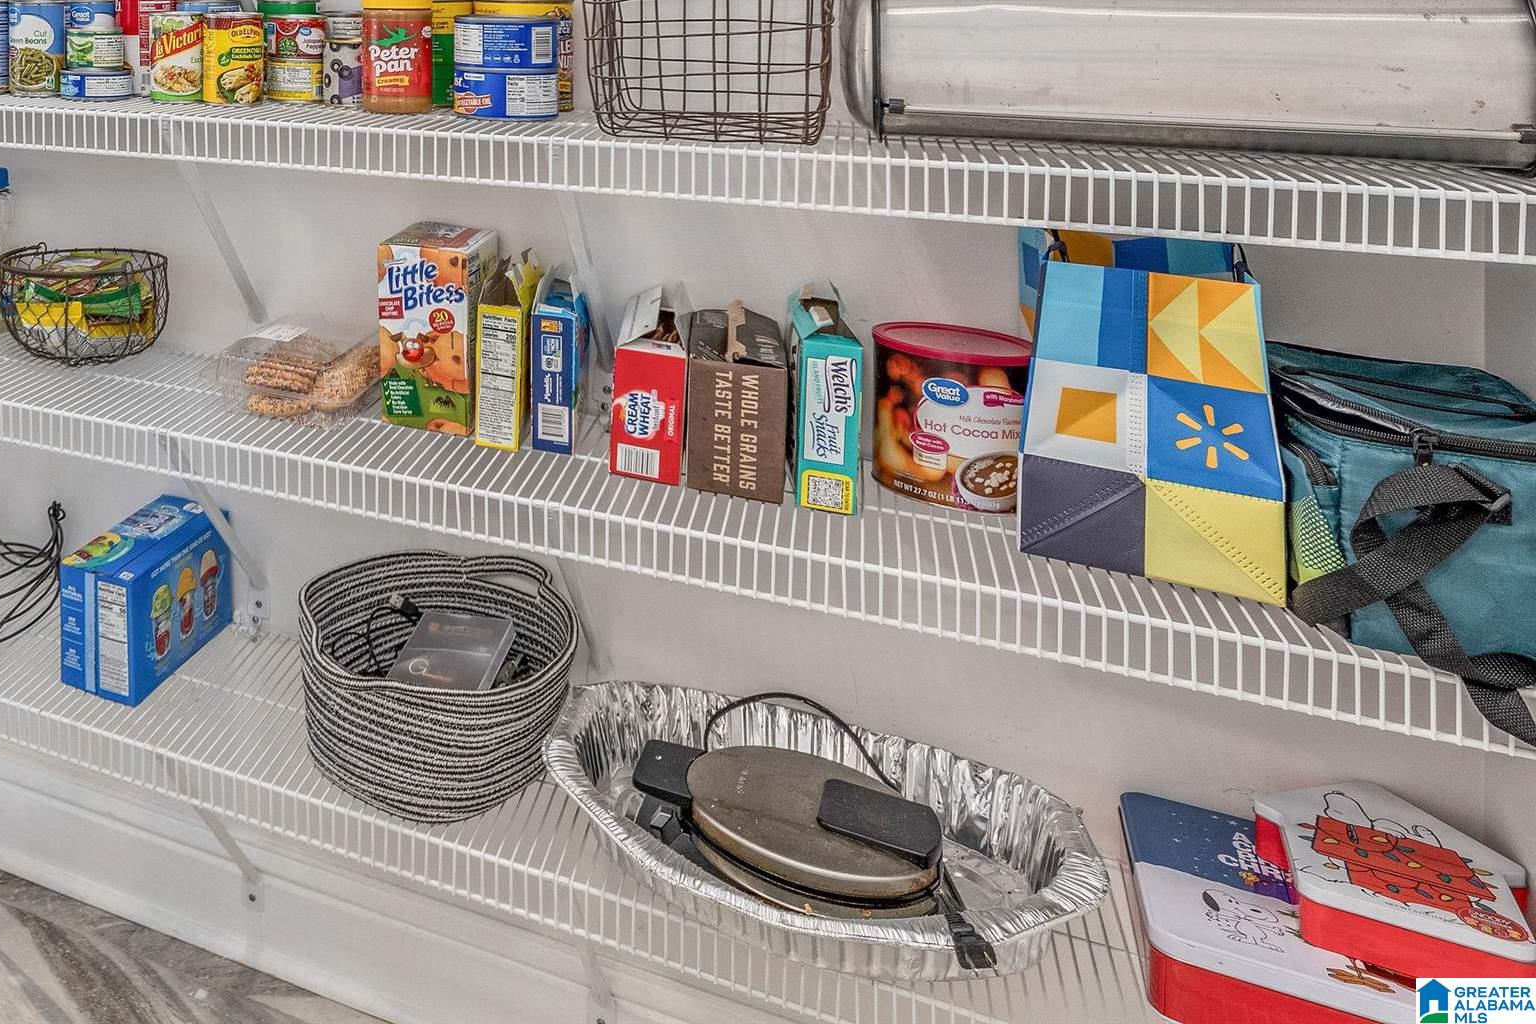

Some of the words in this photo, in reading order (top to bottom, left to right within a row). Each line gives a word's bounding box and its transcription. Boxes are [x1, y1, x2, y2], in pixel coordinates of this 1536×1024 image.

[71, 9, 90, 18] Great
[25, 37, 47, 45] Beans
[33, 30, 47, 38] Cut
[162, 23, 202, 56] Victori
[369, 43, 420, 62] Peter
[377, 77, 405, 86] Creamy
[387, 259, 438, 295] Little
[433, 311, 449, 323] 20
[714, 371, 733, 419] TASTE
[831, 360, 852, 414] Welch's
[927, 382, 961, 397] Great
[935, 391, 961, 402] Value
[625, 393, 639, 435] CREAM
[638, 393, 651, 436] WHEAT
[740, 373, 759, 429] WHOLE
[924, 418, 947, 433] Hot
[951, 424, 999, 440] Cocoa
[1001, 429, 1021, 440] Mix
[973, 416, 1002, 425] Chocolate
[812, 412, 829, 459] Snacks
[826, 423, 842, 456] Fruit
[713, 423, 732, 487] BETTER
[739, 431, 758, 491] GRAINS
[913, 485, 927, 496] 27.7
[928, 490, 938, 499] OZ
